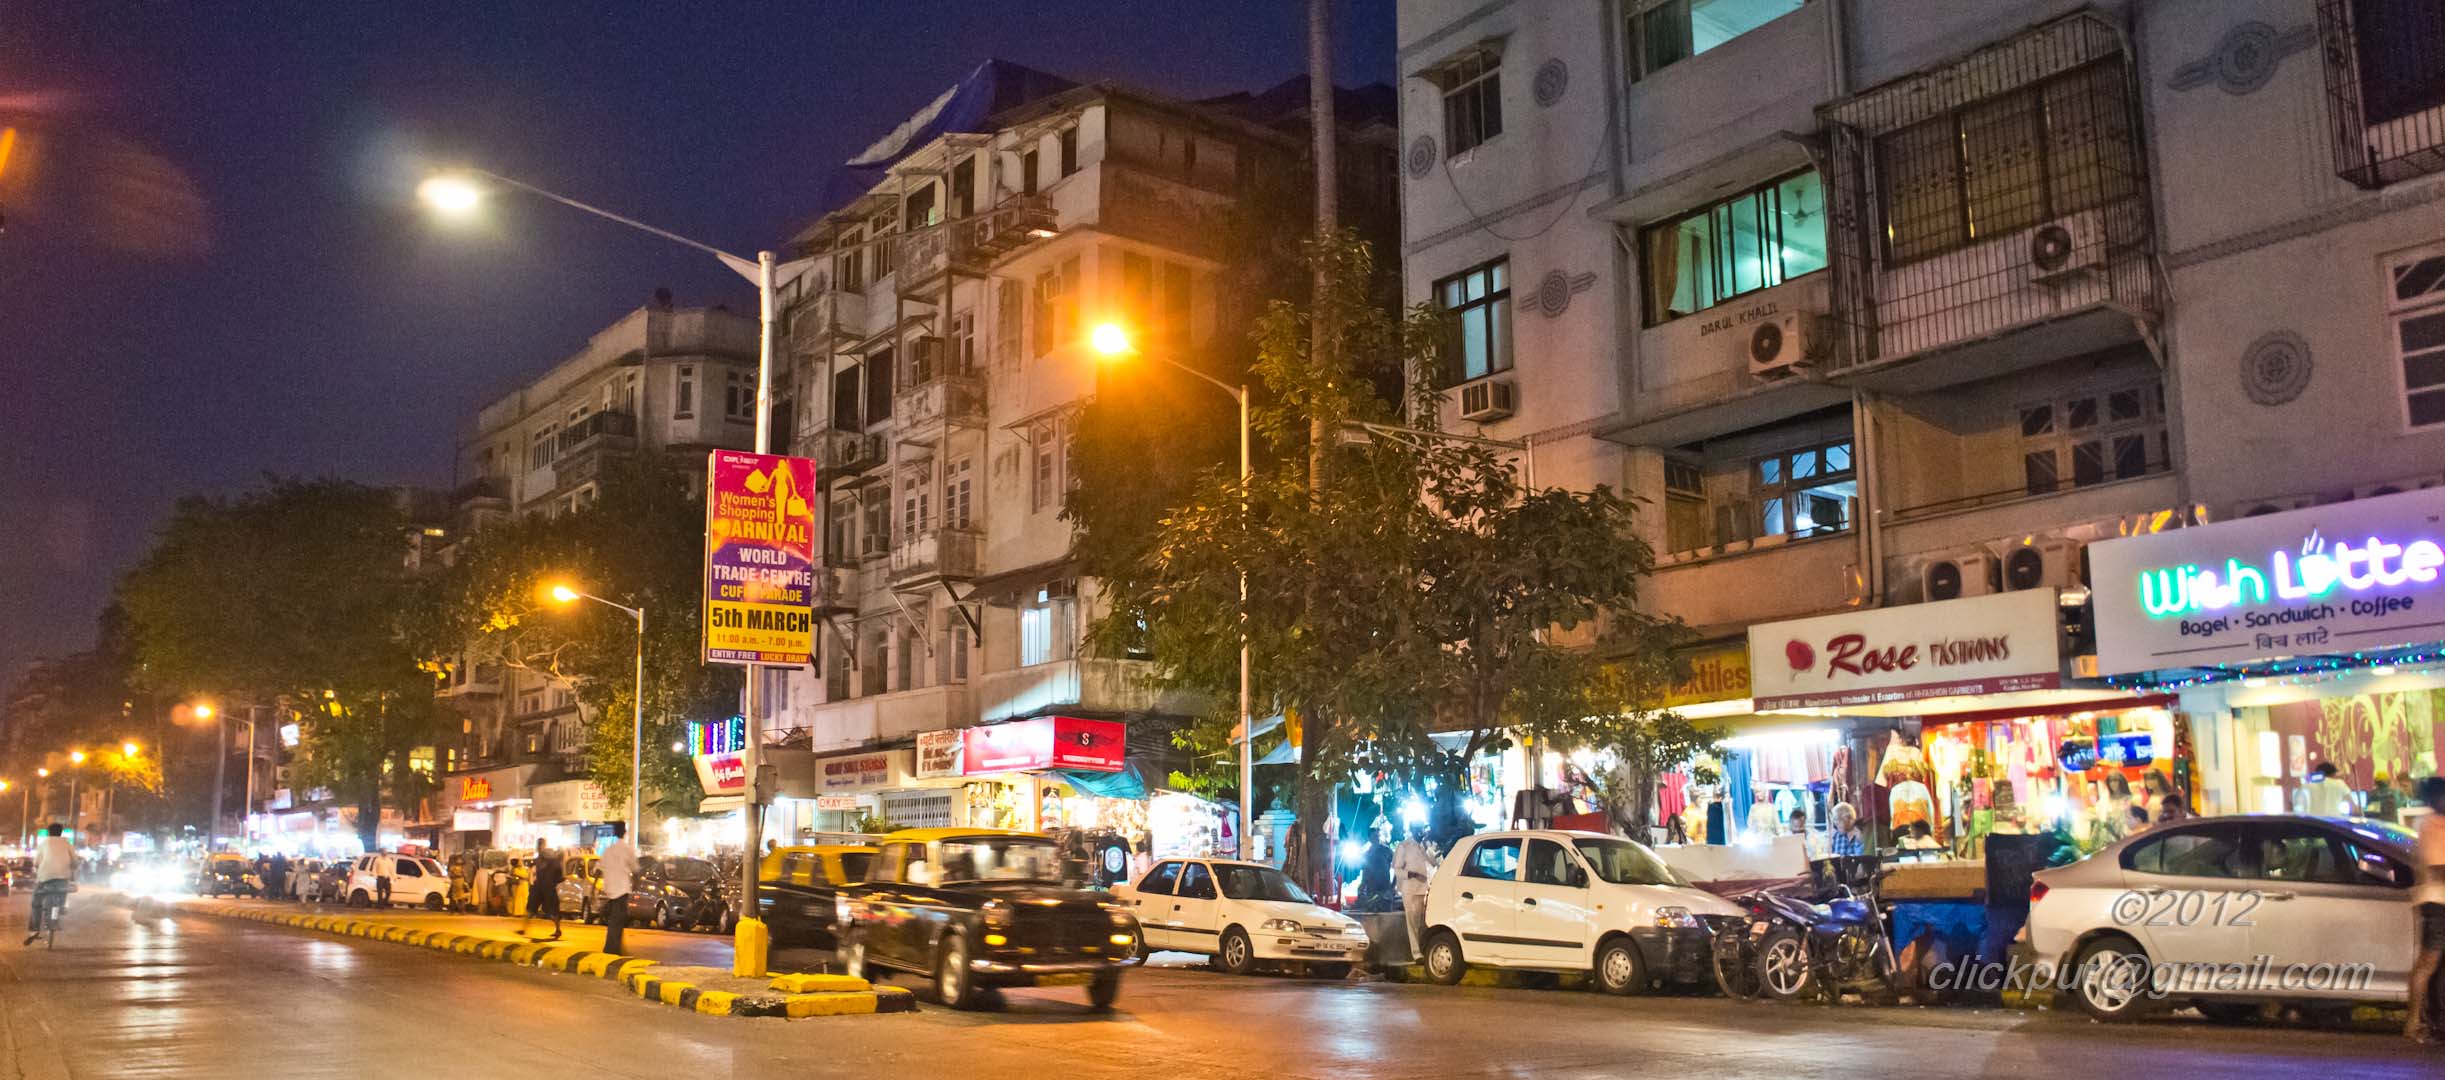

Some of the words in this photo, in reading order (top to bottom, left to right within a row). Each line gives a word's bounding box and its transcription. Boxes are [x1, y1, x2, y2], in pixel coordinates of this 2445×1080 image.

[1700, 316, 1734, 337] DARUL
[1739, 302, 1779, 324] KHALIL
[719, 490, 776, 508] Women's
[719, 503, 775, 523] Shopping
[718, 518, 809, 543] ARNIVAL
[738, 547, 787, 565] WORLD
[712, 564, 757, 582] TRADE
[760, 568, 811, 586] CENTRE
[712, 607, 743, 628] 5th
[747, 609, 809, 633] MARCH
[2180, 616, 2228, 637] Bagel
[2245, 603, 2334, 629] Sandwich
[2351, 595, 2415, 618] Coffee
[711, 649, 736, 659] ENTRY
[737, 651, 757, 660] FREE
[1826, 633, 1919, 679] Rose
[461, 775, 489, 801] Bata
